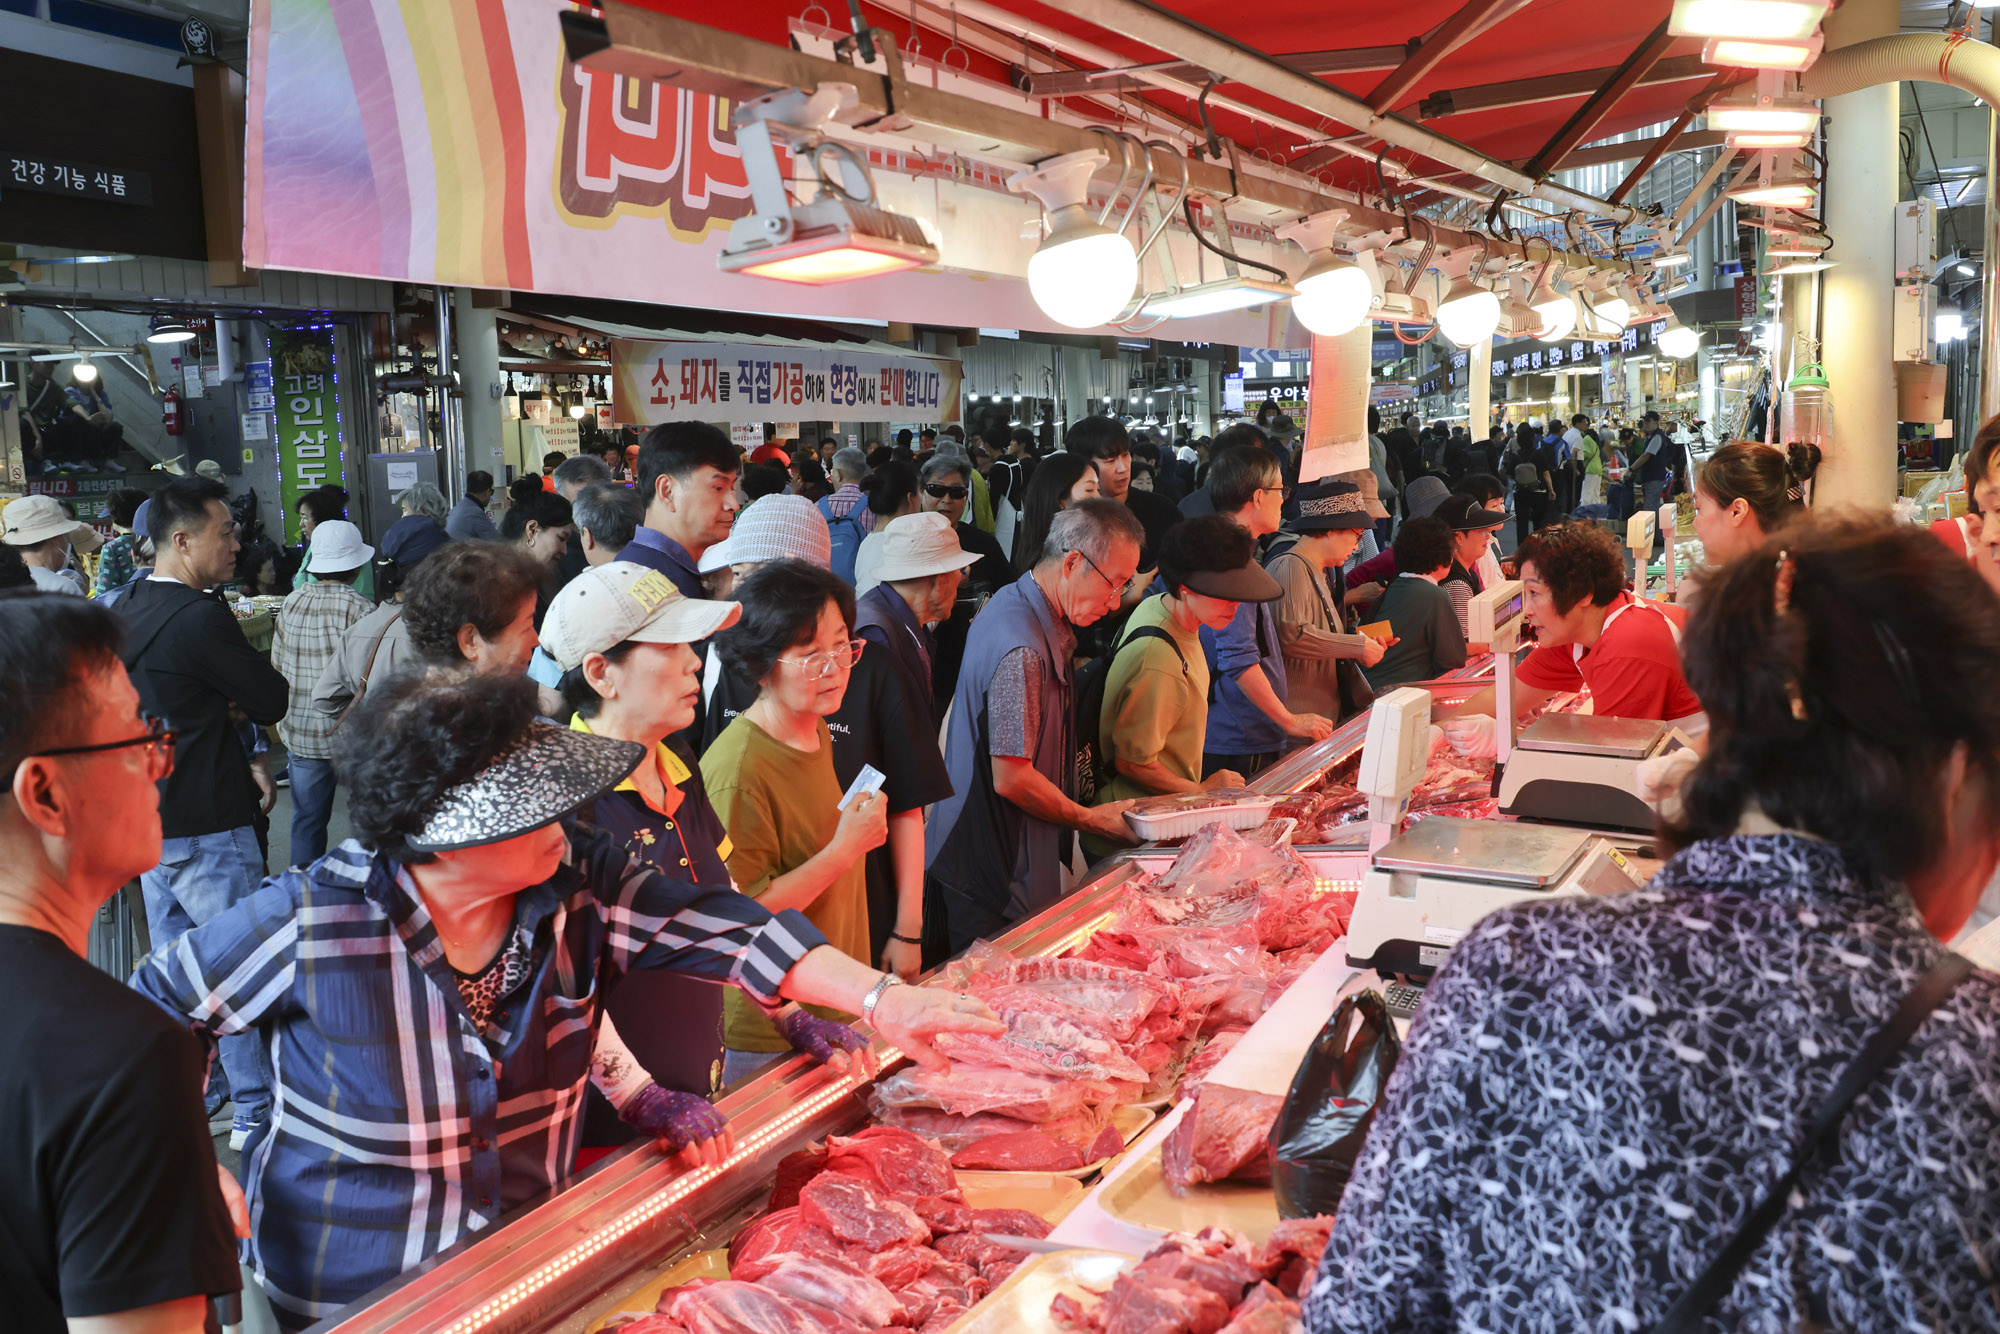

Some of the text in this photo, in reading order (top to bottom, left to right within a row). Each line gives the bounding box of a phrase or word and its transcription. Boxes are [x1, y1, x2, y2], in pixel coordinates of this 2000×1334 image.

[11, 159, 126, 196] 건강 기능 식품
[284, 373, 326, 395] 고려
[736, 359, 826, 406] 직접가공하여
[829, 363, 877, 408] 현장에서
[879, 367, 940, 409] 판매합니다
